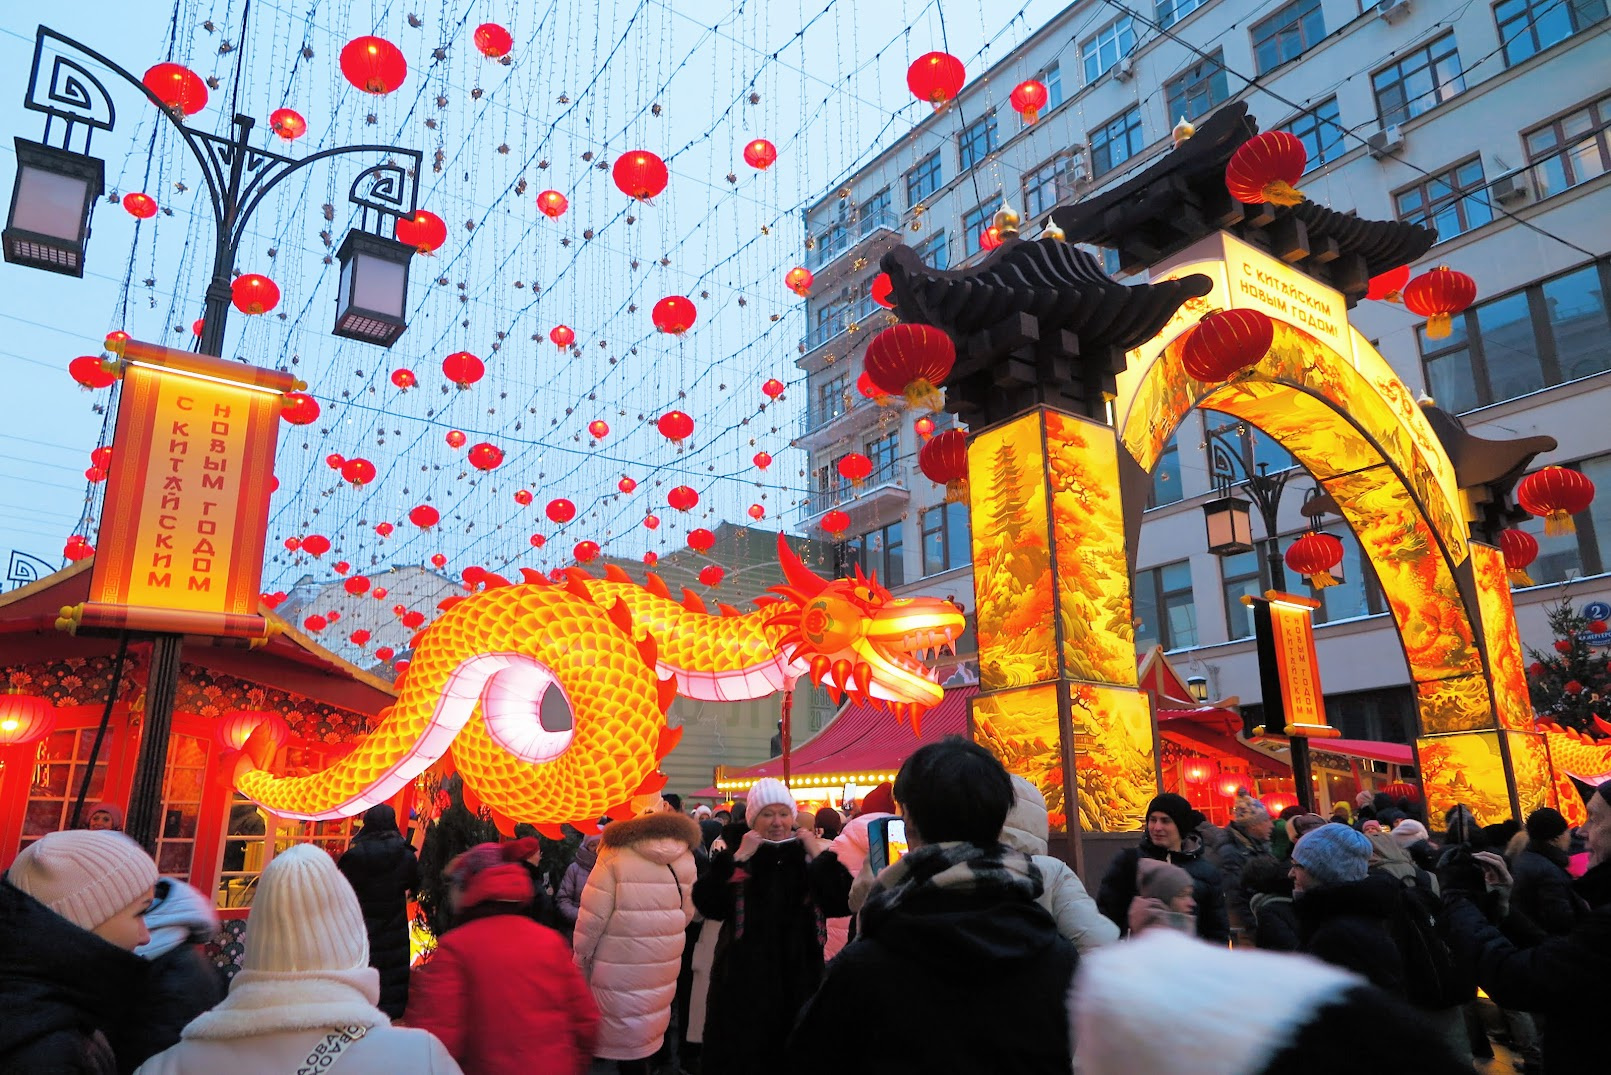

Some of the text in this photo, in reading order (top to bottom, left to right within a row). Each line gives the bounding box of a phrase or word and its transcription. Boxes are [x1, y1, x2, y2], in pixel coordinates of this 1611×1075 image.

[1240, 279, 1338, 338] НОВЫМ ГОДОМ!
[1242, 262, 1331, 317] С КИТАЙСКИМ
[147, 396, 194, 588] С КИТАЙСКИМ
[188, 403, 231, 593] НОВЫМ ГОДОМ
[1591, 605, 1602, 619] 2
[1293, 617, 1314, 716] НОВЫМ ГОДОМ
